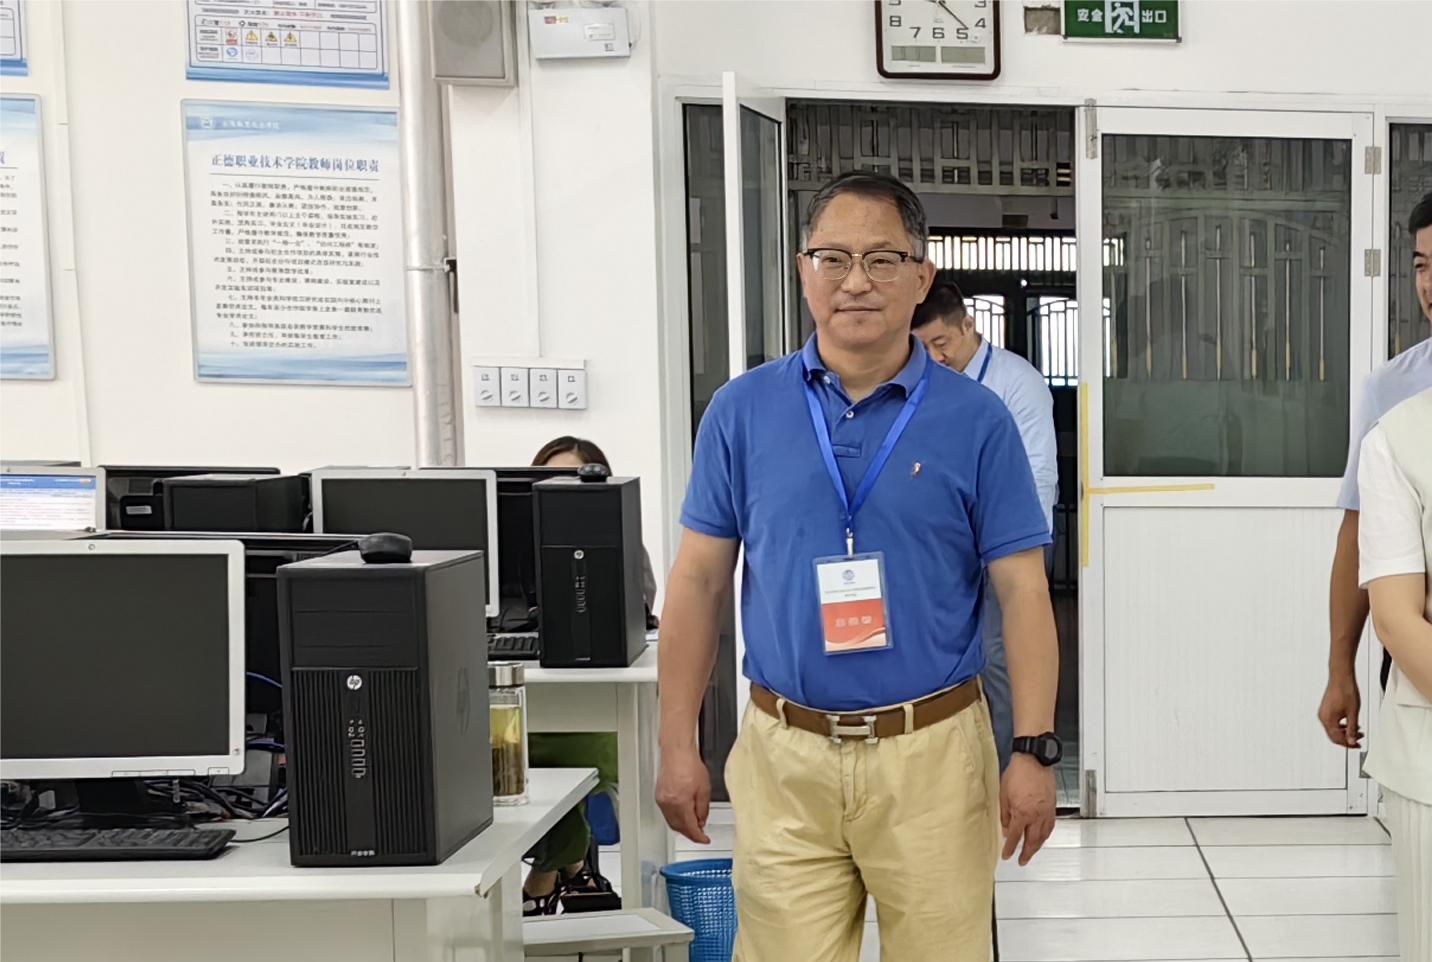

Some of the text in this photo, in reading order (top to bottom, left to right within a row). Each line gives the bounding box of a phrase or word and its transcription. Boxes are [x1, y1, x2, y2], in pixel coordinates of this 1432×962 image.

[889, 15, 902, 27] 8
[1077, 8, 1167, 23] 安全 出口
[974, 17, 986, 28] 4
[909, 26, 922, 38] 7
[932, 27, 945, 39] 6
[956, 28, 969, 39] 5
[211, 153, 379, 173] 正德职业技术学院教师岗位职责
